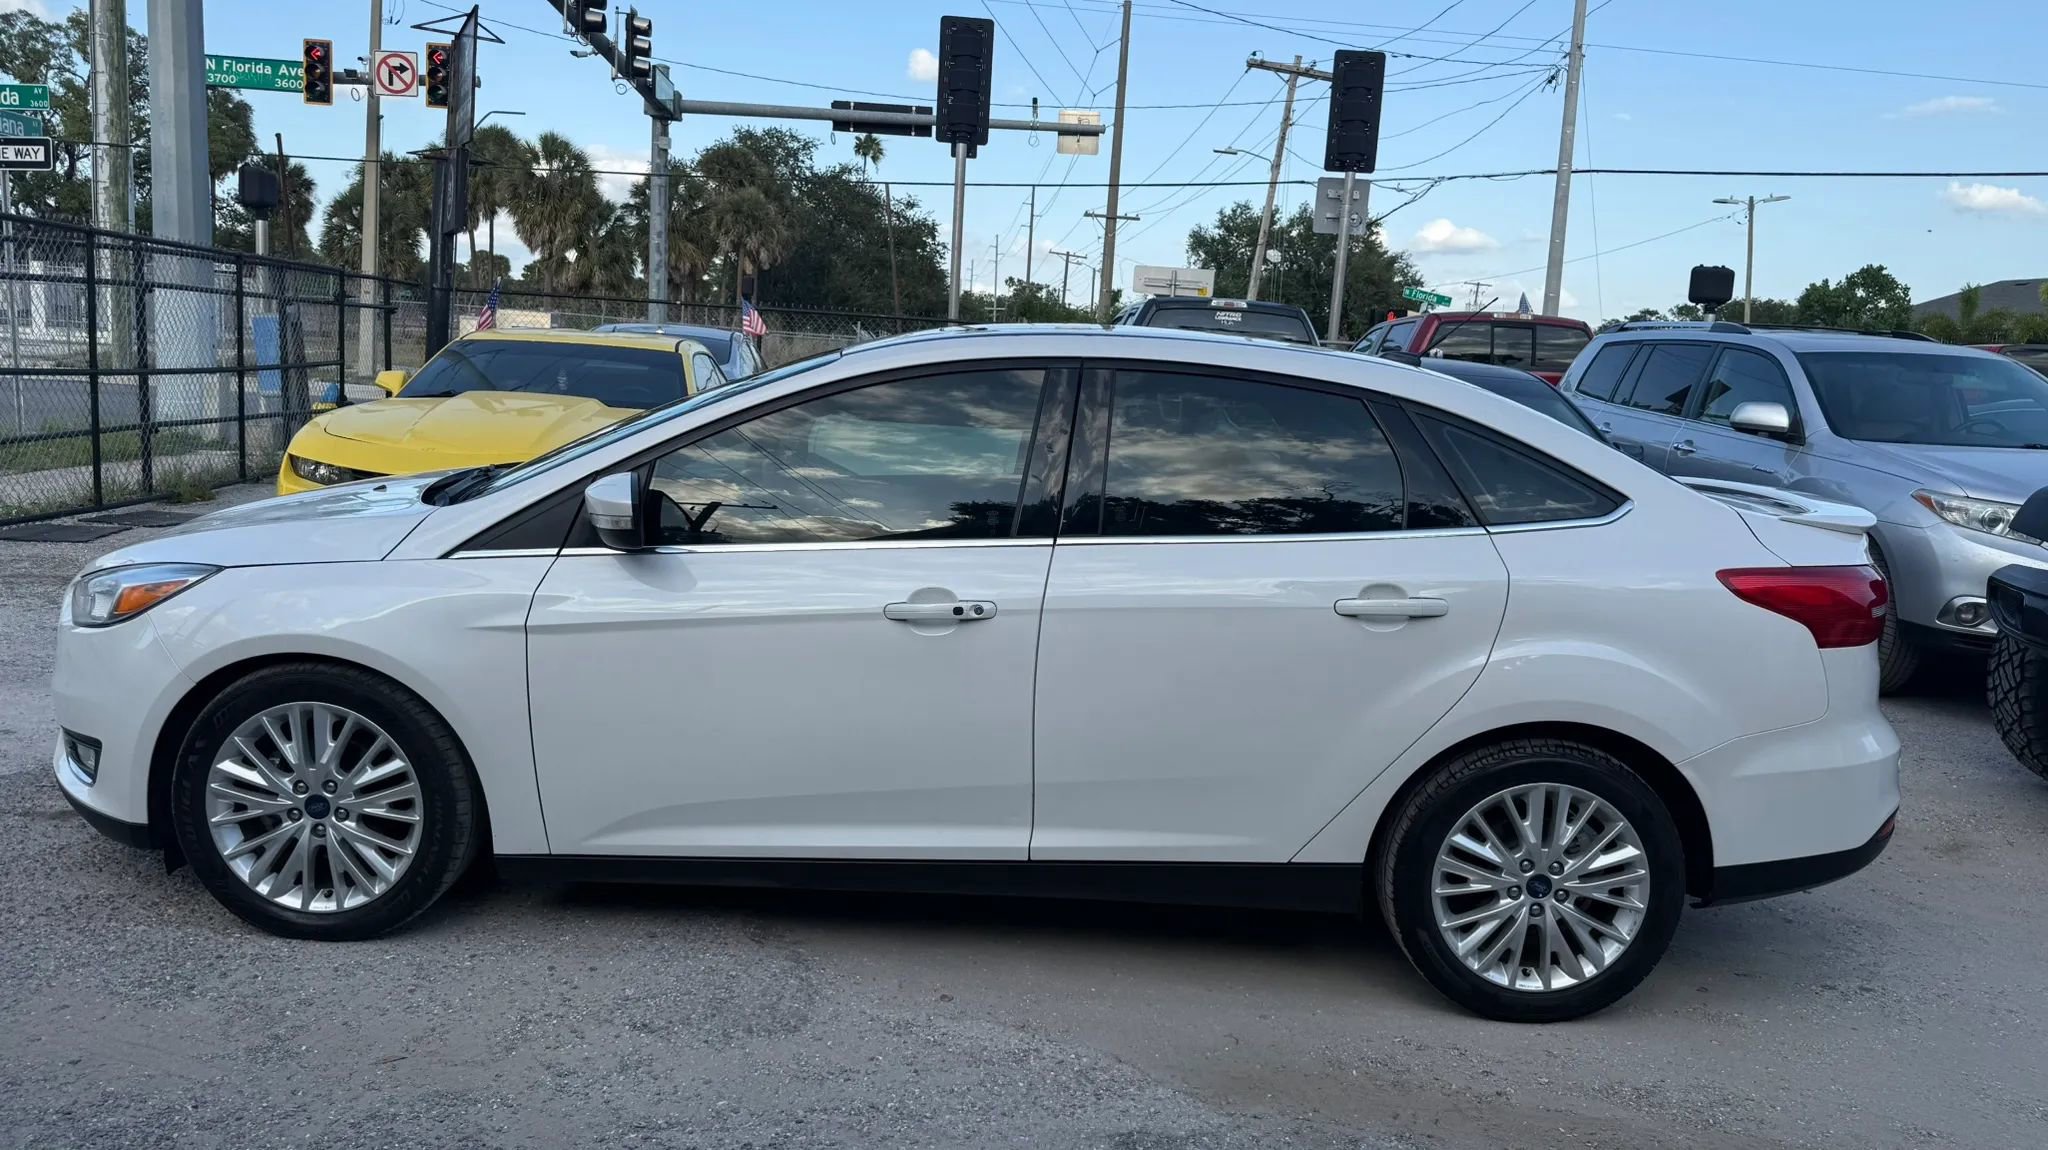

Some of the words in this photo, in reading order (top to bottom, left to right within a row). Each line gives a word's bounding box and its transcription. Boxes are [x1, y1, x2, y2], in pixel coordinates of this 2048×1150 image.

[205, 58, 216, 70] N
[223, 59, 272, 75] Florida
[278, 63, 304, 77] Ave
[207, 73, 236, 84] 3700
[274, 78, 304, 89] 3600
[30, 99, 48, 108] 3600
[14, 147, 40, 160] WAY
[1411, 289, 1437, 302] Florida
